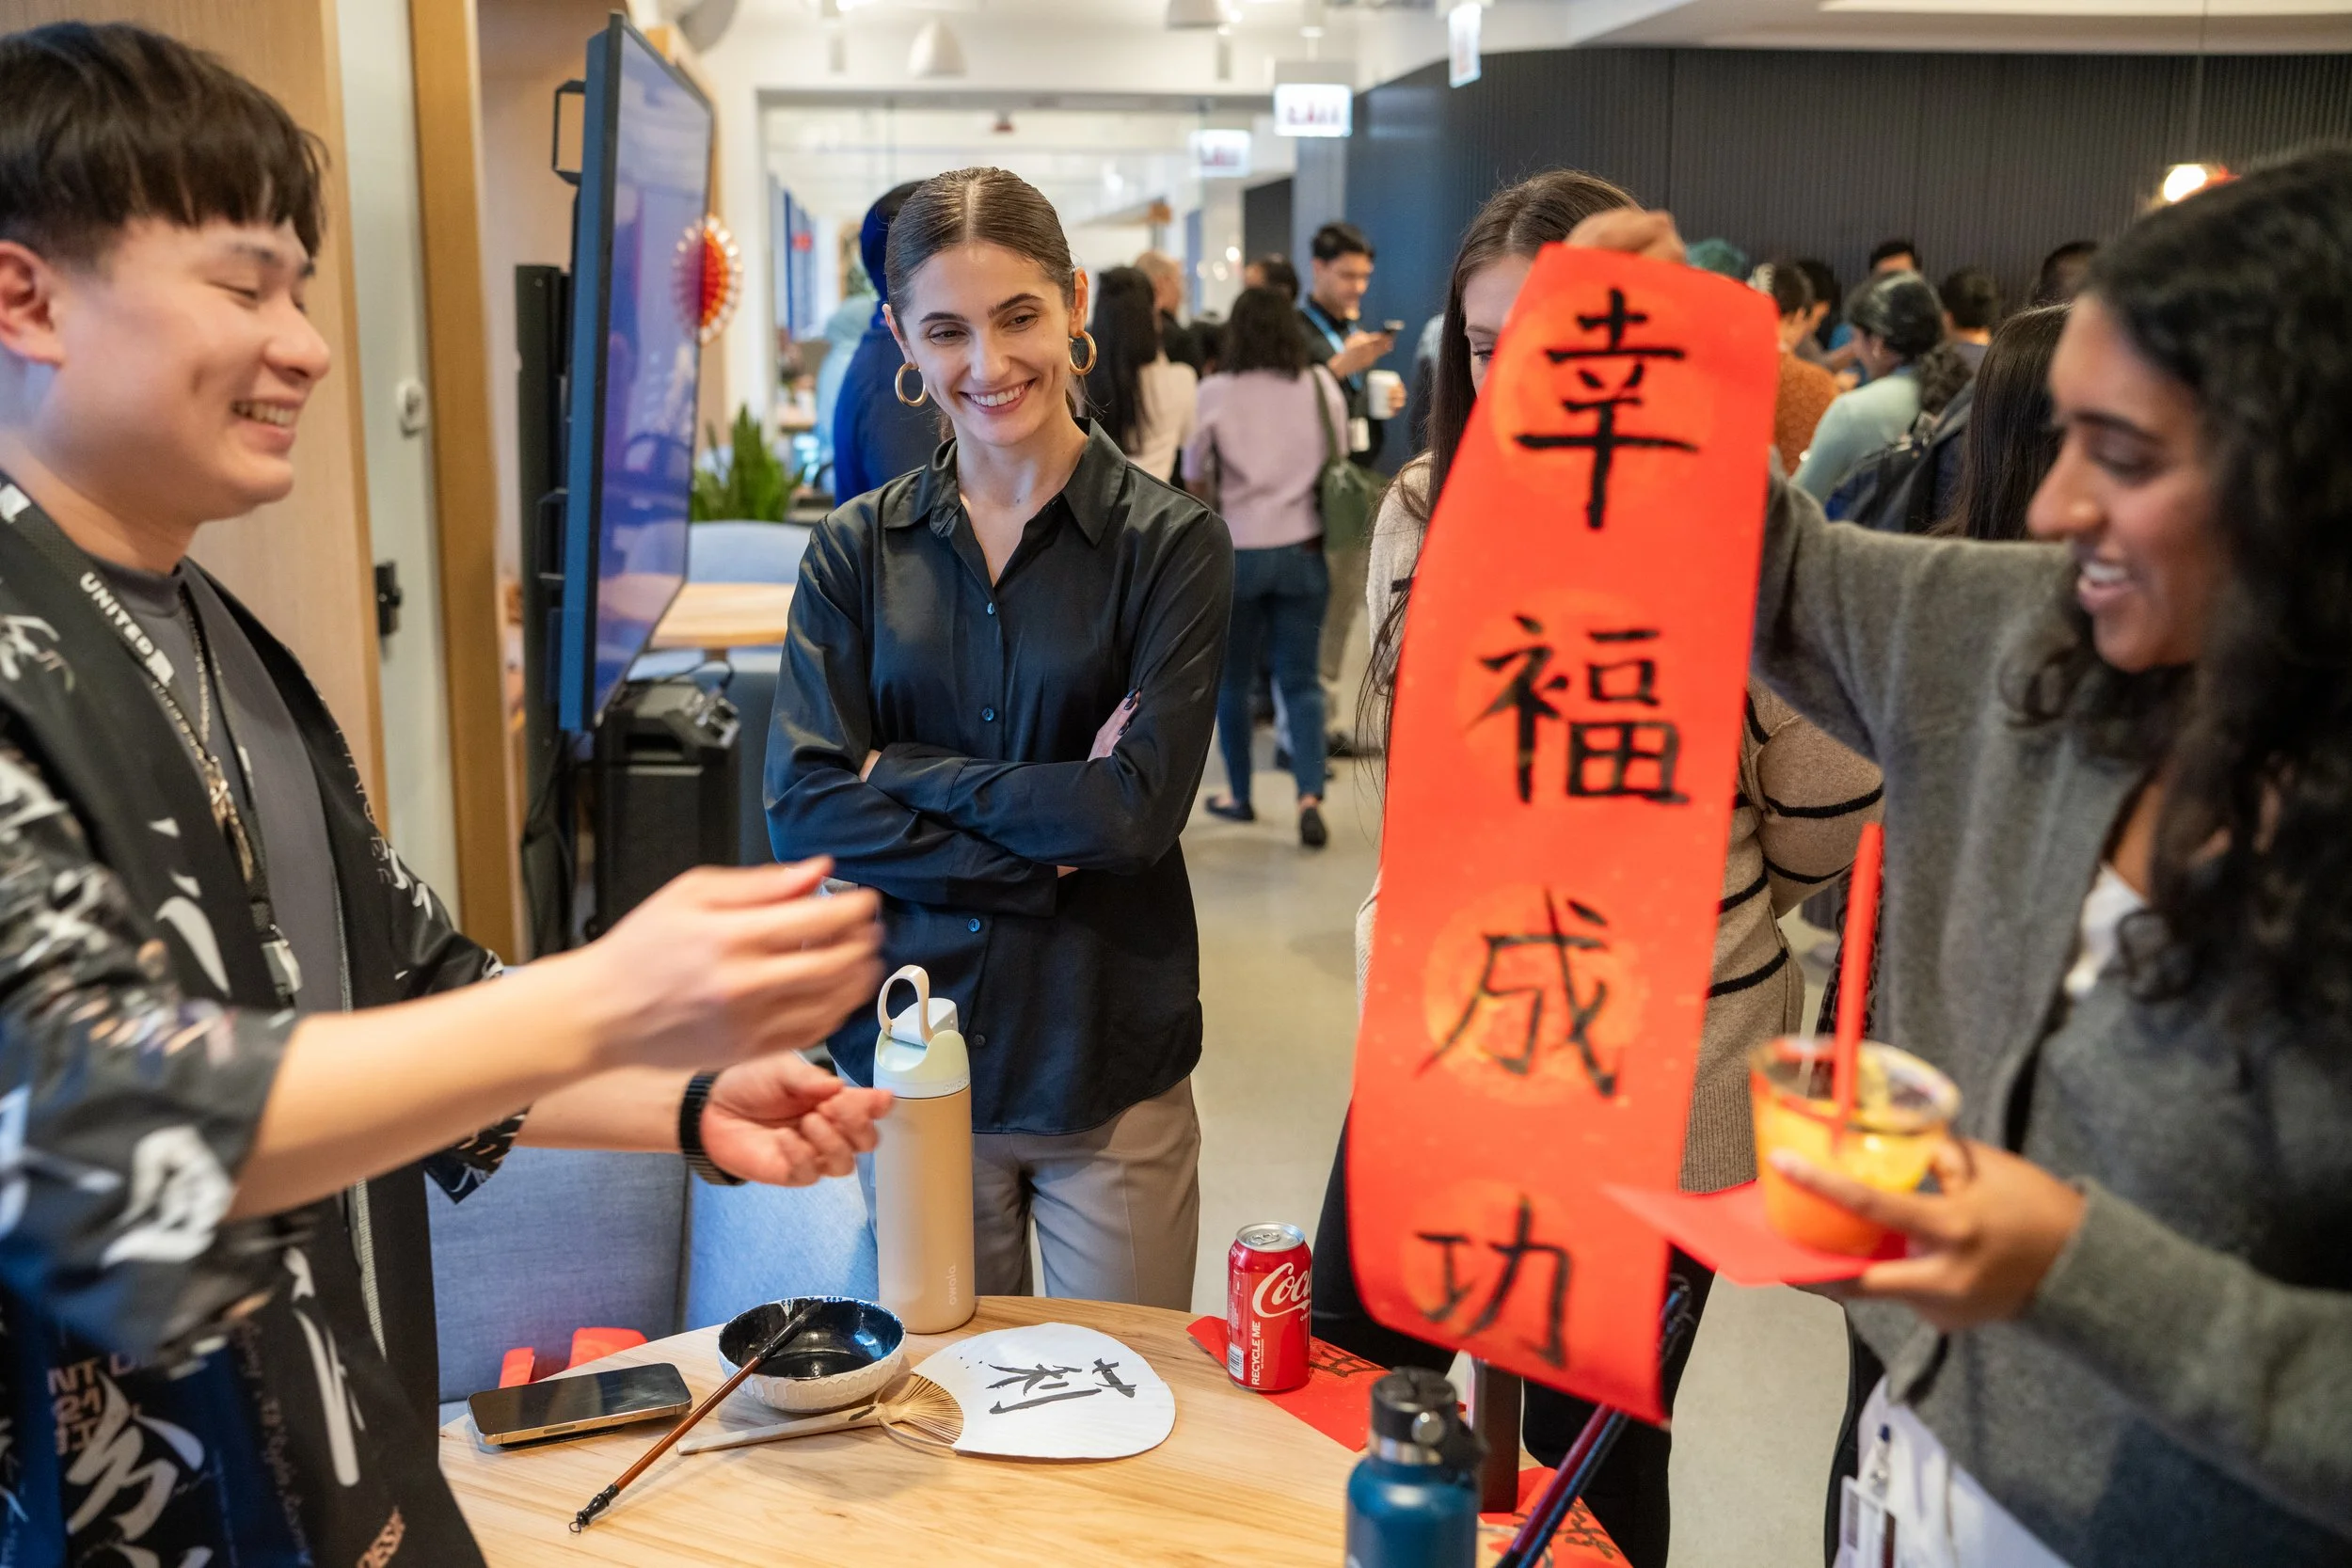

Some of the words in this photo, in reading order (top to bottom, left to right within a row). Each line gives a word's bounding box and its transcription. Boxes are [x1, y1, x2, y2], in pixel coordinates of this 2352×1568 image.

[80, 571, 154, 657] UNITED
[1416, 286, 1699, 1370] 幸福成功
[946, 1264, 957, 1306] owala
[1251, 1320, 1262, 1338] ME
[1251, 1338, 1262, 1386] RECYCLE
